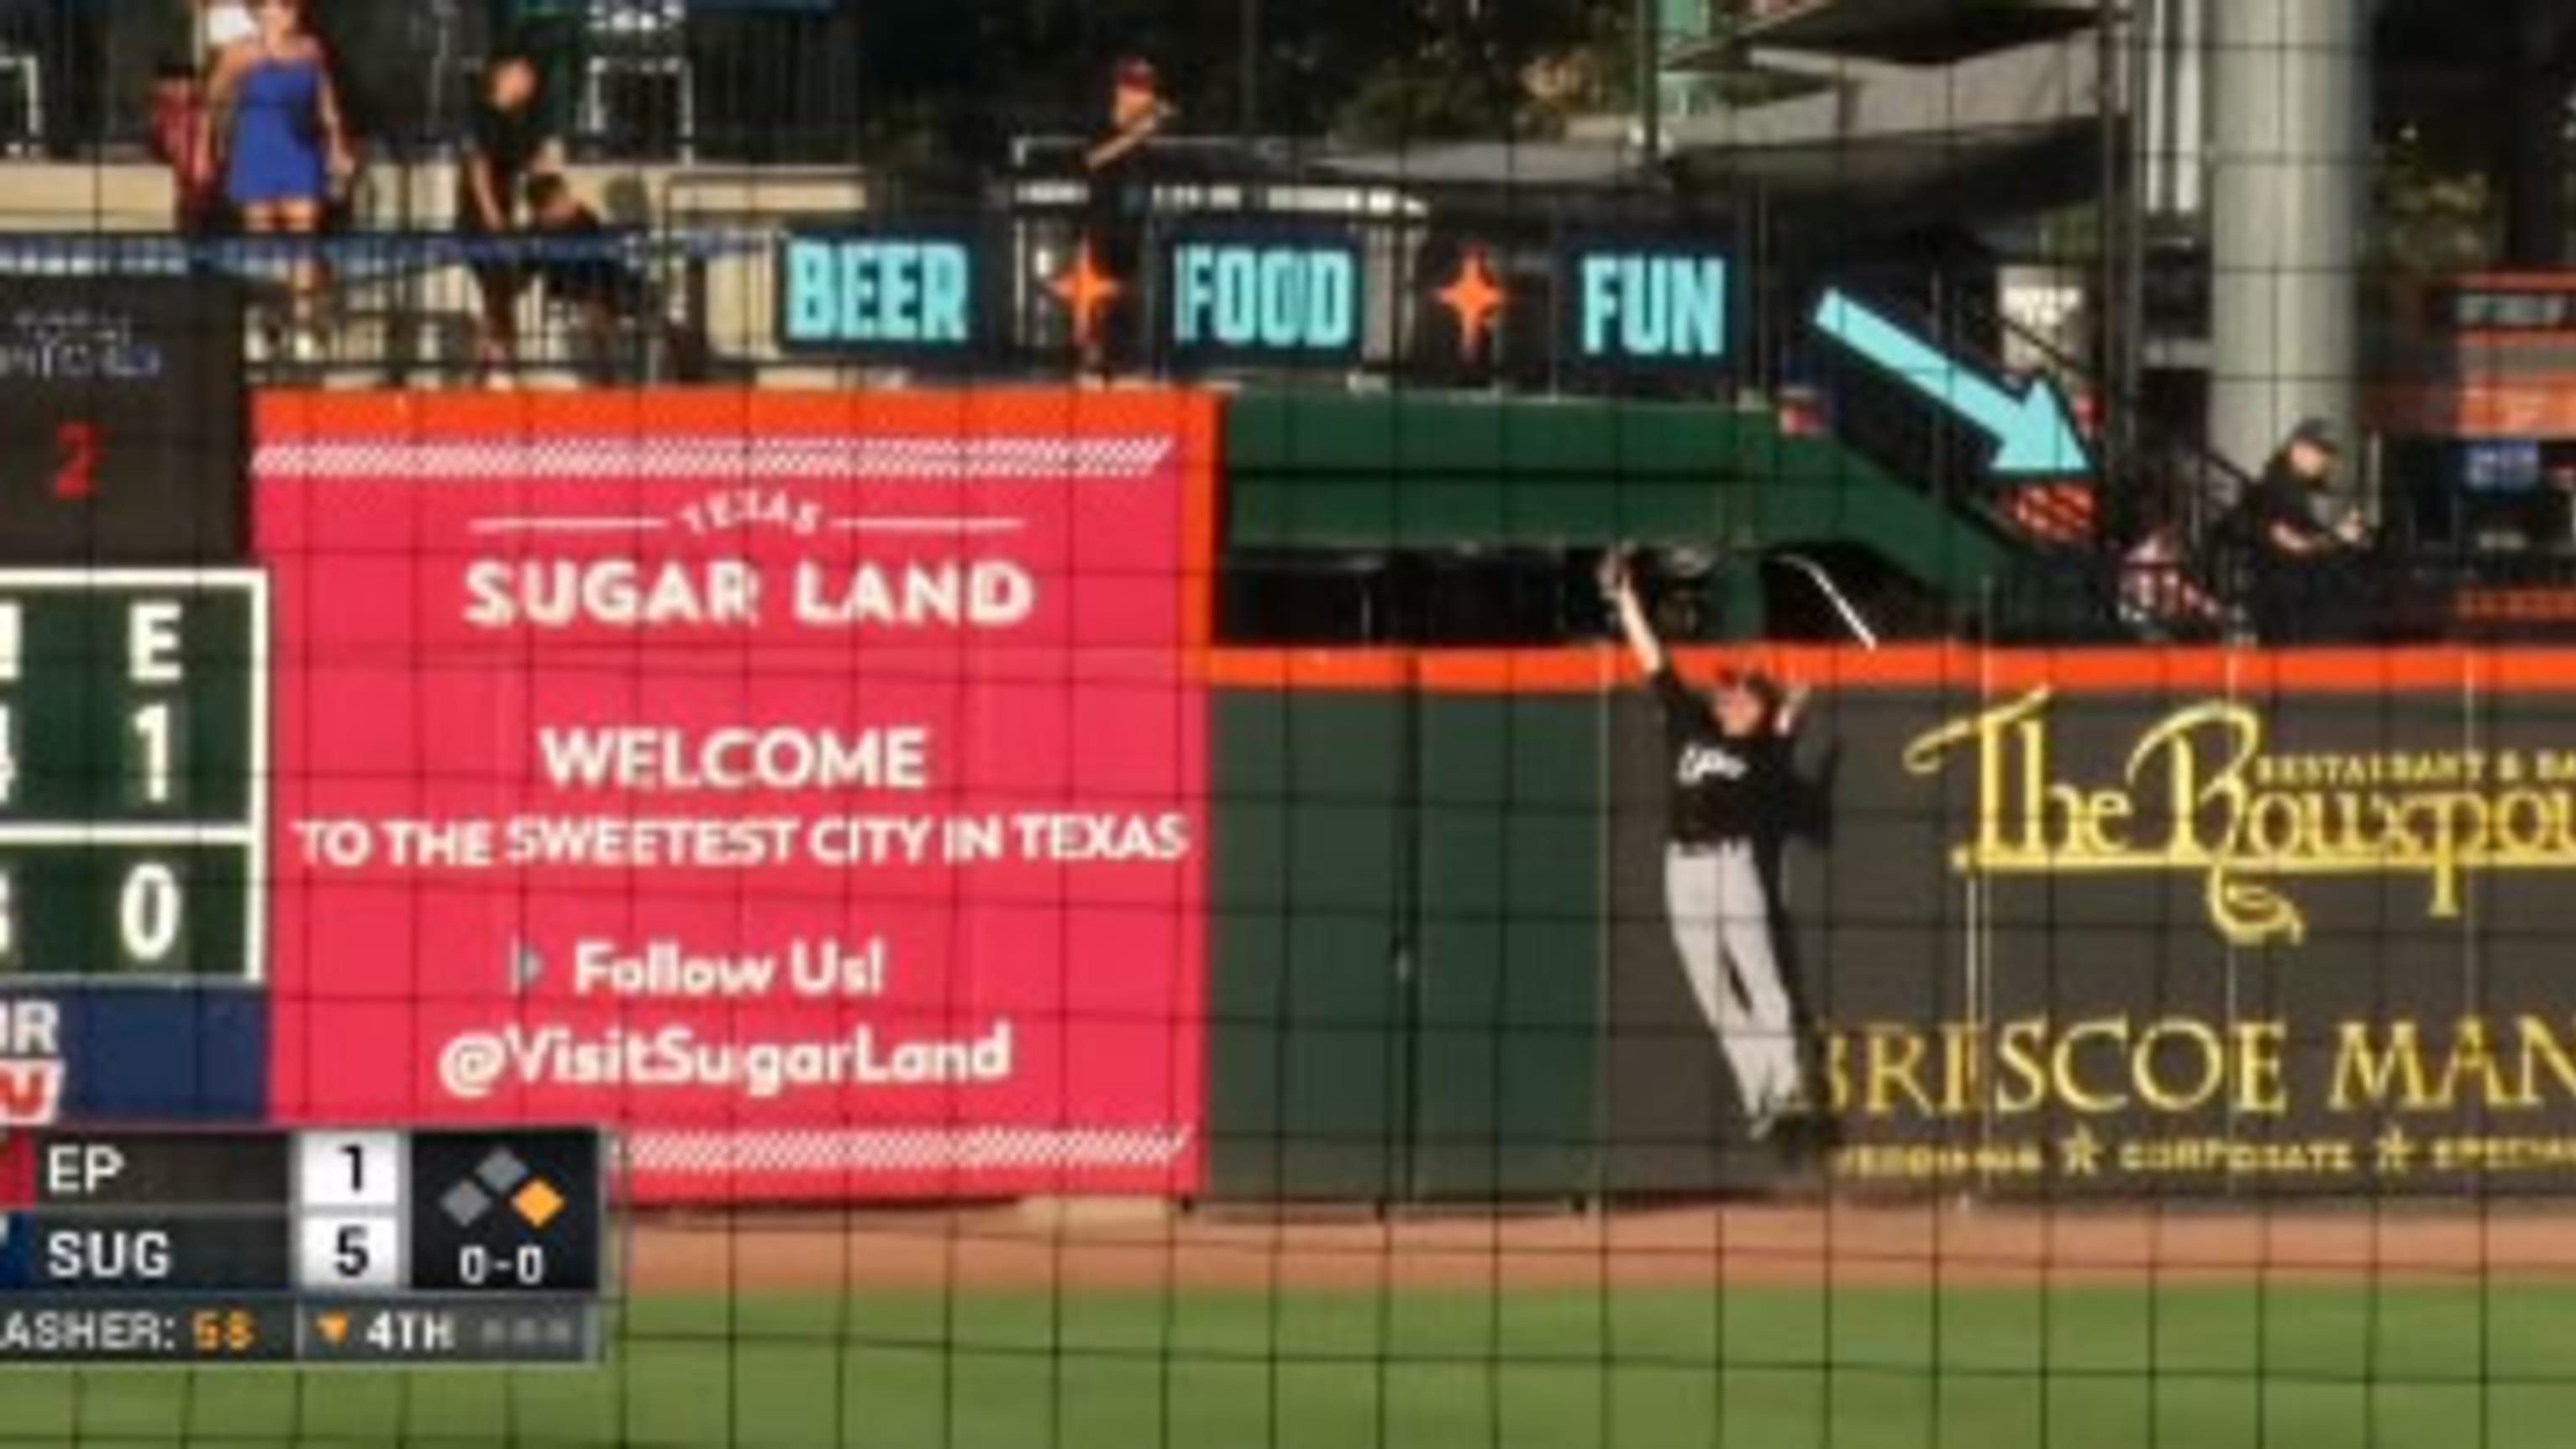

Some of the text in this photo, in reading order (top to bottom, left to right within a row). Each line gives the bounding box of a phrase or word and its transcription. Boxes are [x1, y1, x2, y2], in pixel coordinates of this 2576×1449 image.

[786, 238, 1726, 354] BEER FOOD FUN
[54, 423, 104, 498] 2
[680, 487, 823, 536] TEXAS
[463, 557, 1036, 627] SUGAR LAND
[129, 601, 182, 681] E
[132, 702, 171, 802] 1
[539, 725, 928, 790] WELCOME
[1902, 685, 2132, 865] The
[290, 811, 1191, 868] TO THE SWEETEST CITY IN TEXAS
[119, 862, 181, 962] 0
[574, 936, 886, 998] Follow Us!
[437, 1018, 1012, 1099] @VisitSugarLand
[2117, 1138, 2353, 1171] CORPORATE
